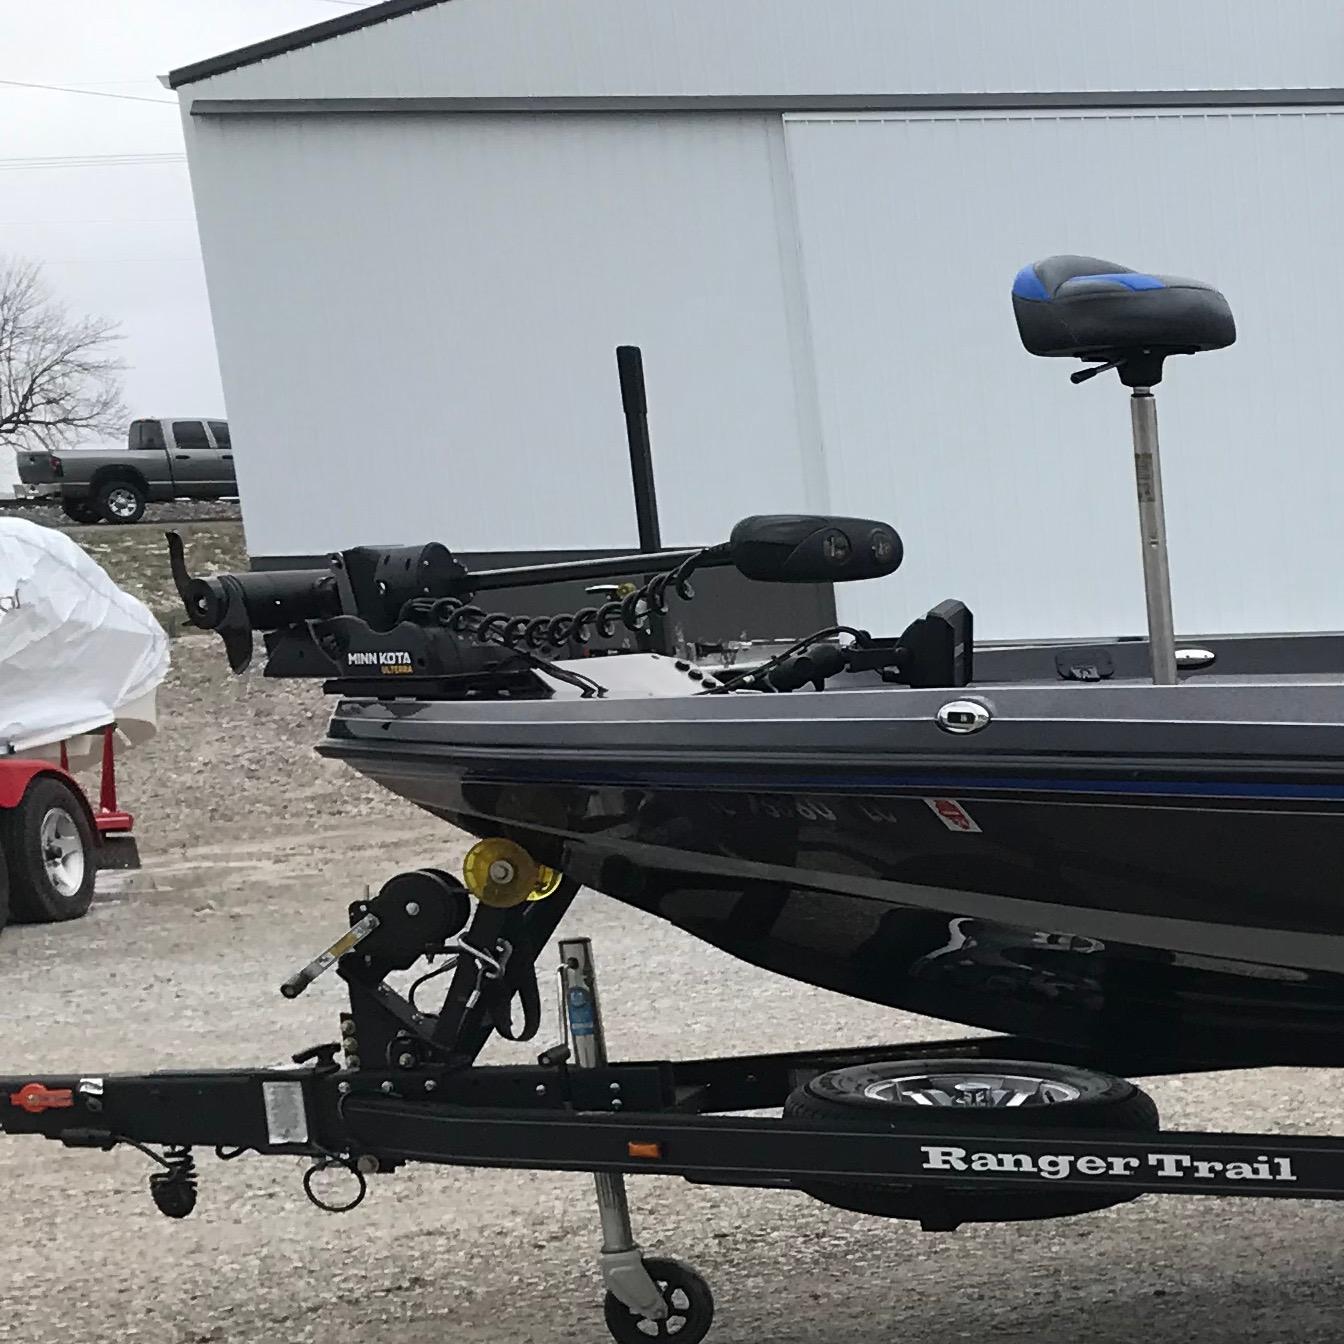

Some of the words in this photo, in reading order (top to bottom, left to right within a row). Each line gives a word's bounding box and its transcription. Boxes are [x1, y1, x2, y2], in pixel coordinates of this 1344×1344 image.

[347, 652, 378, 665] MINN
[379, 651, 411, 664] KOTA
[920, 1146, 1140, 1180] Ranger
[1148, 1153, 1298, 1181] Trail
